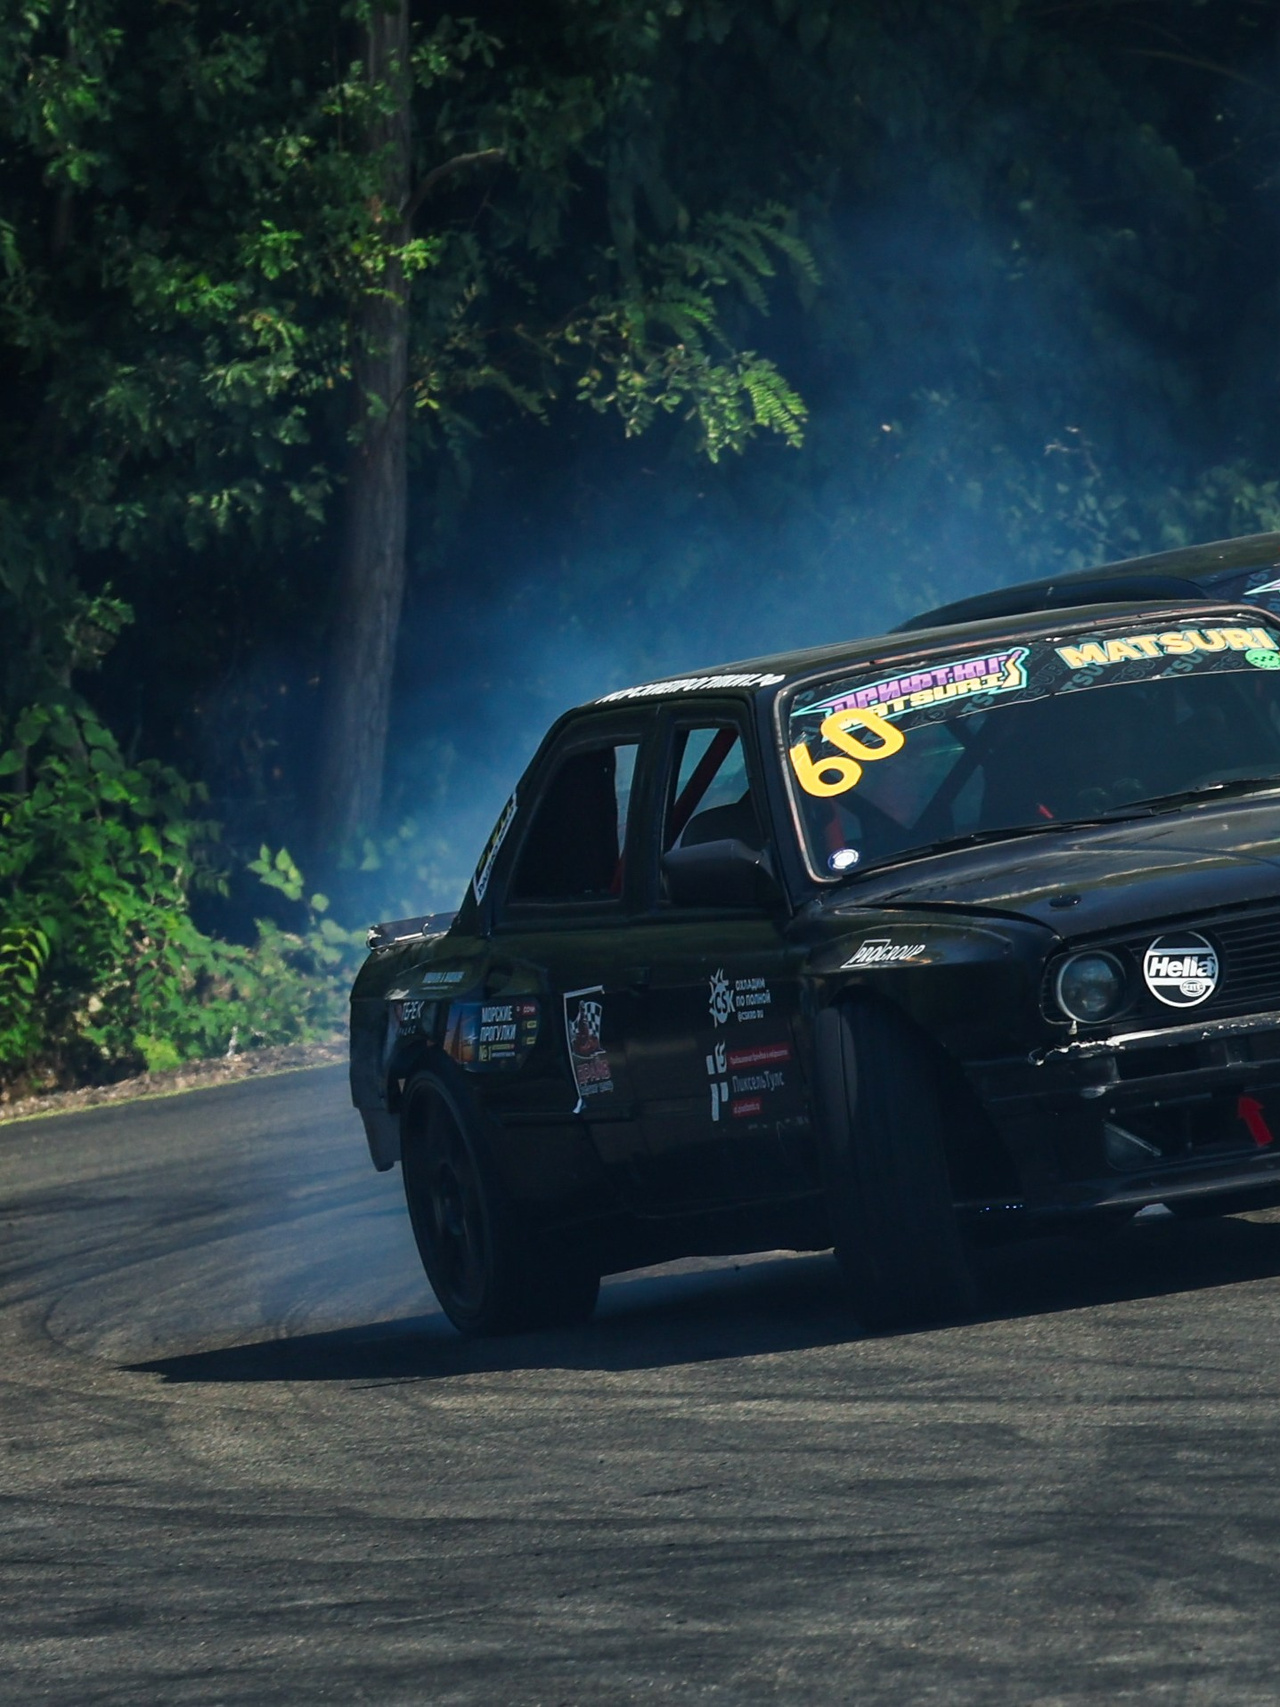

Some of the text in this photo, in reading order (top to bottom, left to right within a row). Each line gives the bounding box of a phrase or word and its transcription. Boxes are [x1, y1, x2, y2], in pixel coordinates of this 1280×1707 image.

[1053, 627, 1280, 669] MATSURI
[789, 708, 905, 798] 60
[1149, 955, 1215, 978] Hella
[715, 989, 736, 1014] CSK
[736, 994, 746, 1007] ПО
[482, 1006, 513, 1023] МОРСКИЕ
[480, 1024, 517, 1042] ПРОГУЛКИ
